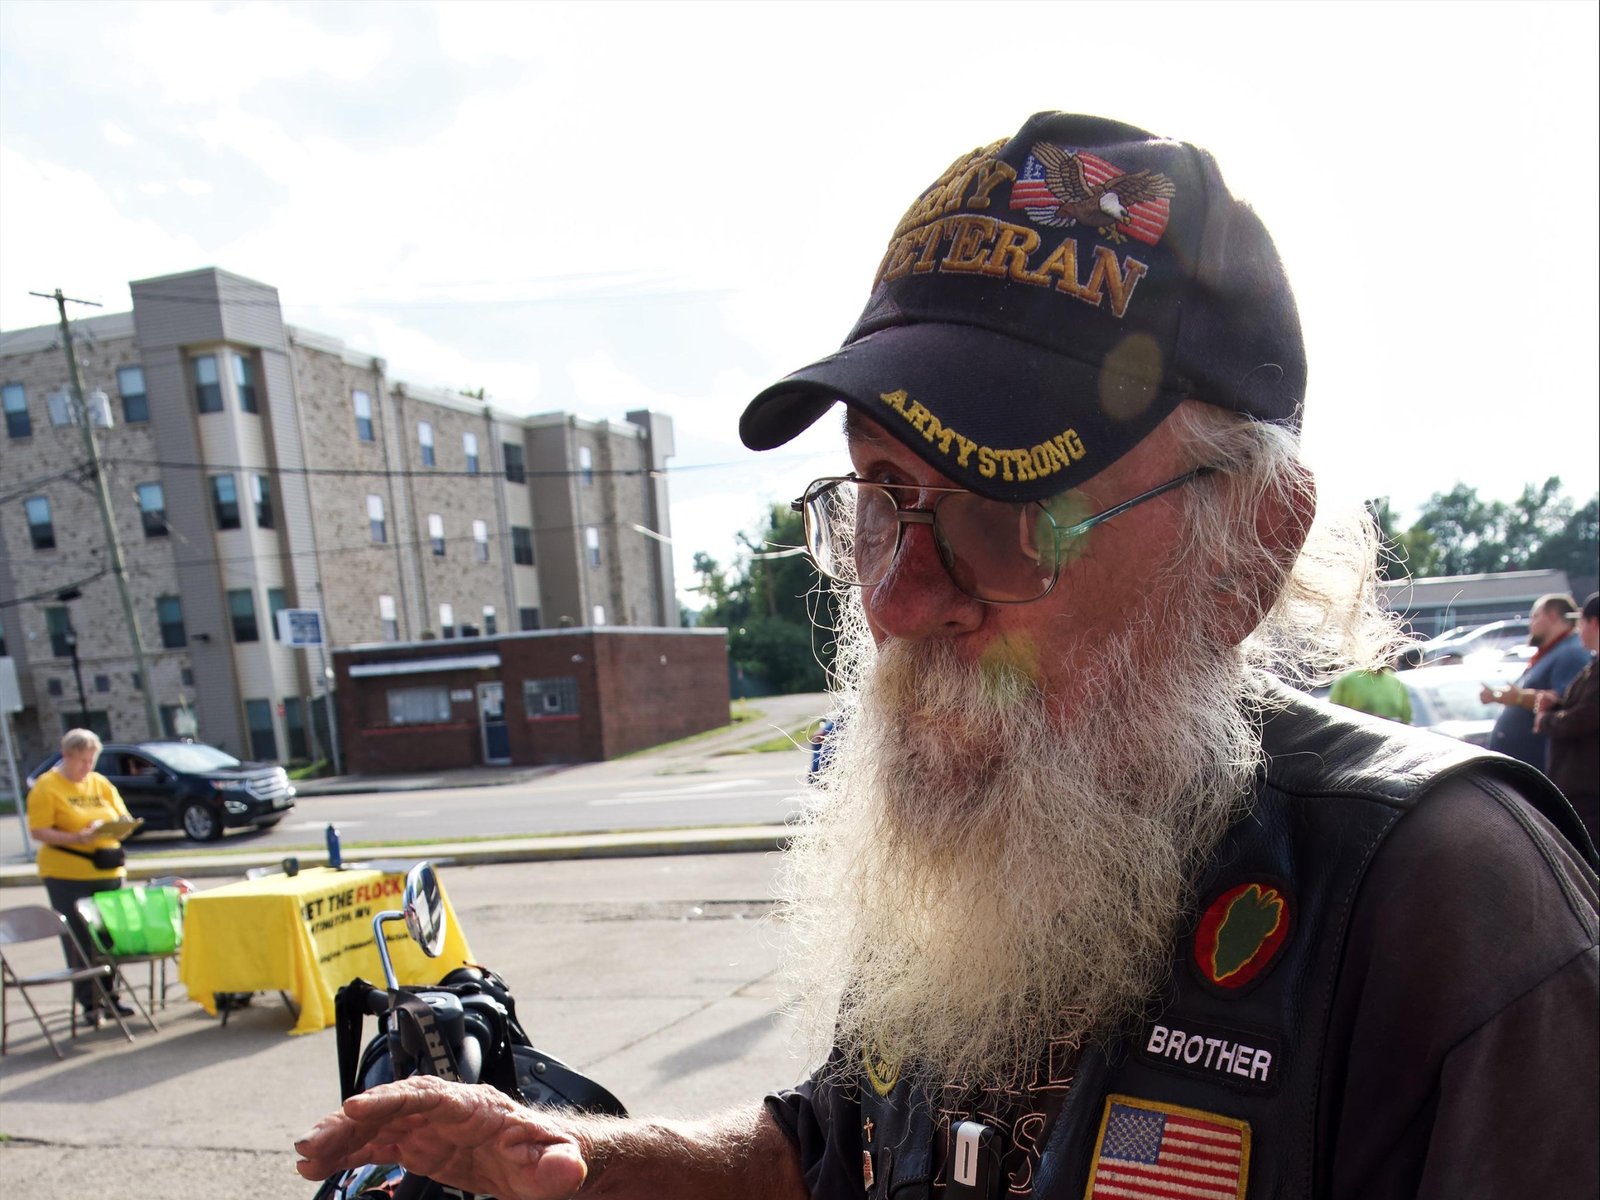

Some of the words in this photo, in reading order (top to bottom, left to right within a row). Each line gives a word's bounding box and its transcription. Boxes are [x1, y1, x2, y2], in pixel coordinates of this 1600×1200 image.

[303, 898, 323, 920] ET
[326, 889, 354, 912] THE
[355, 877, 403, 904] FLOCK
[1146, 1025, 1273, 1082] BROTHER
